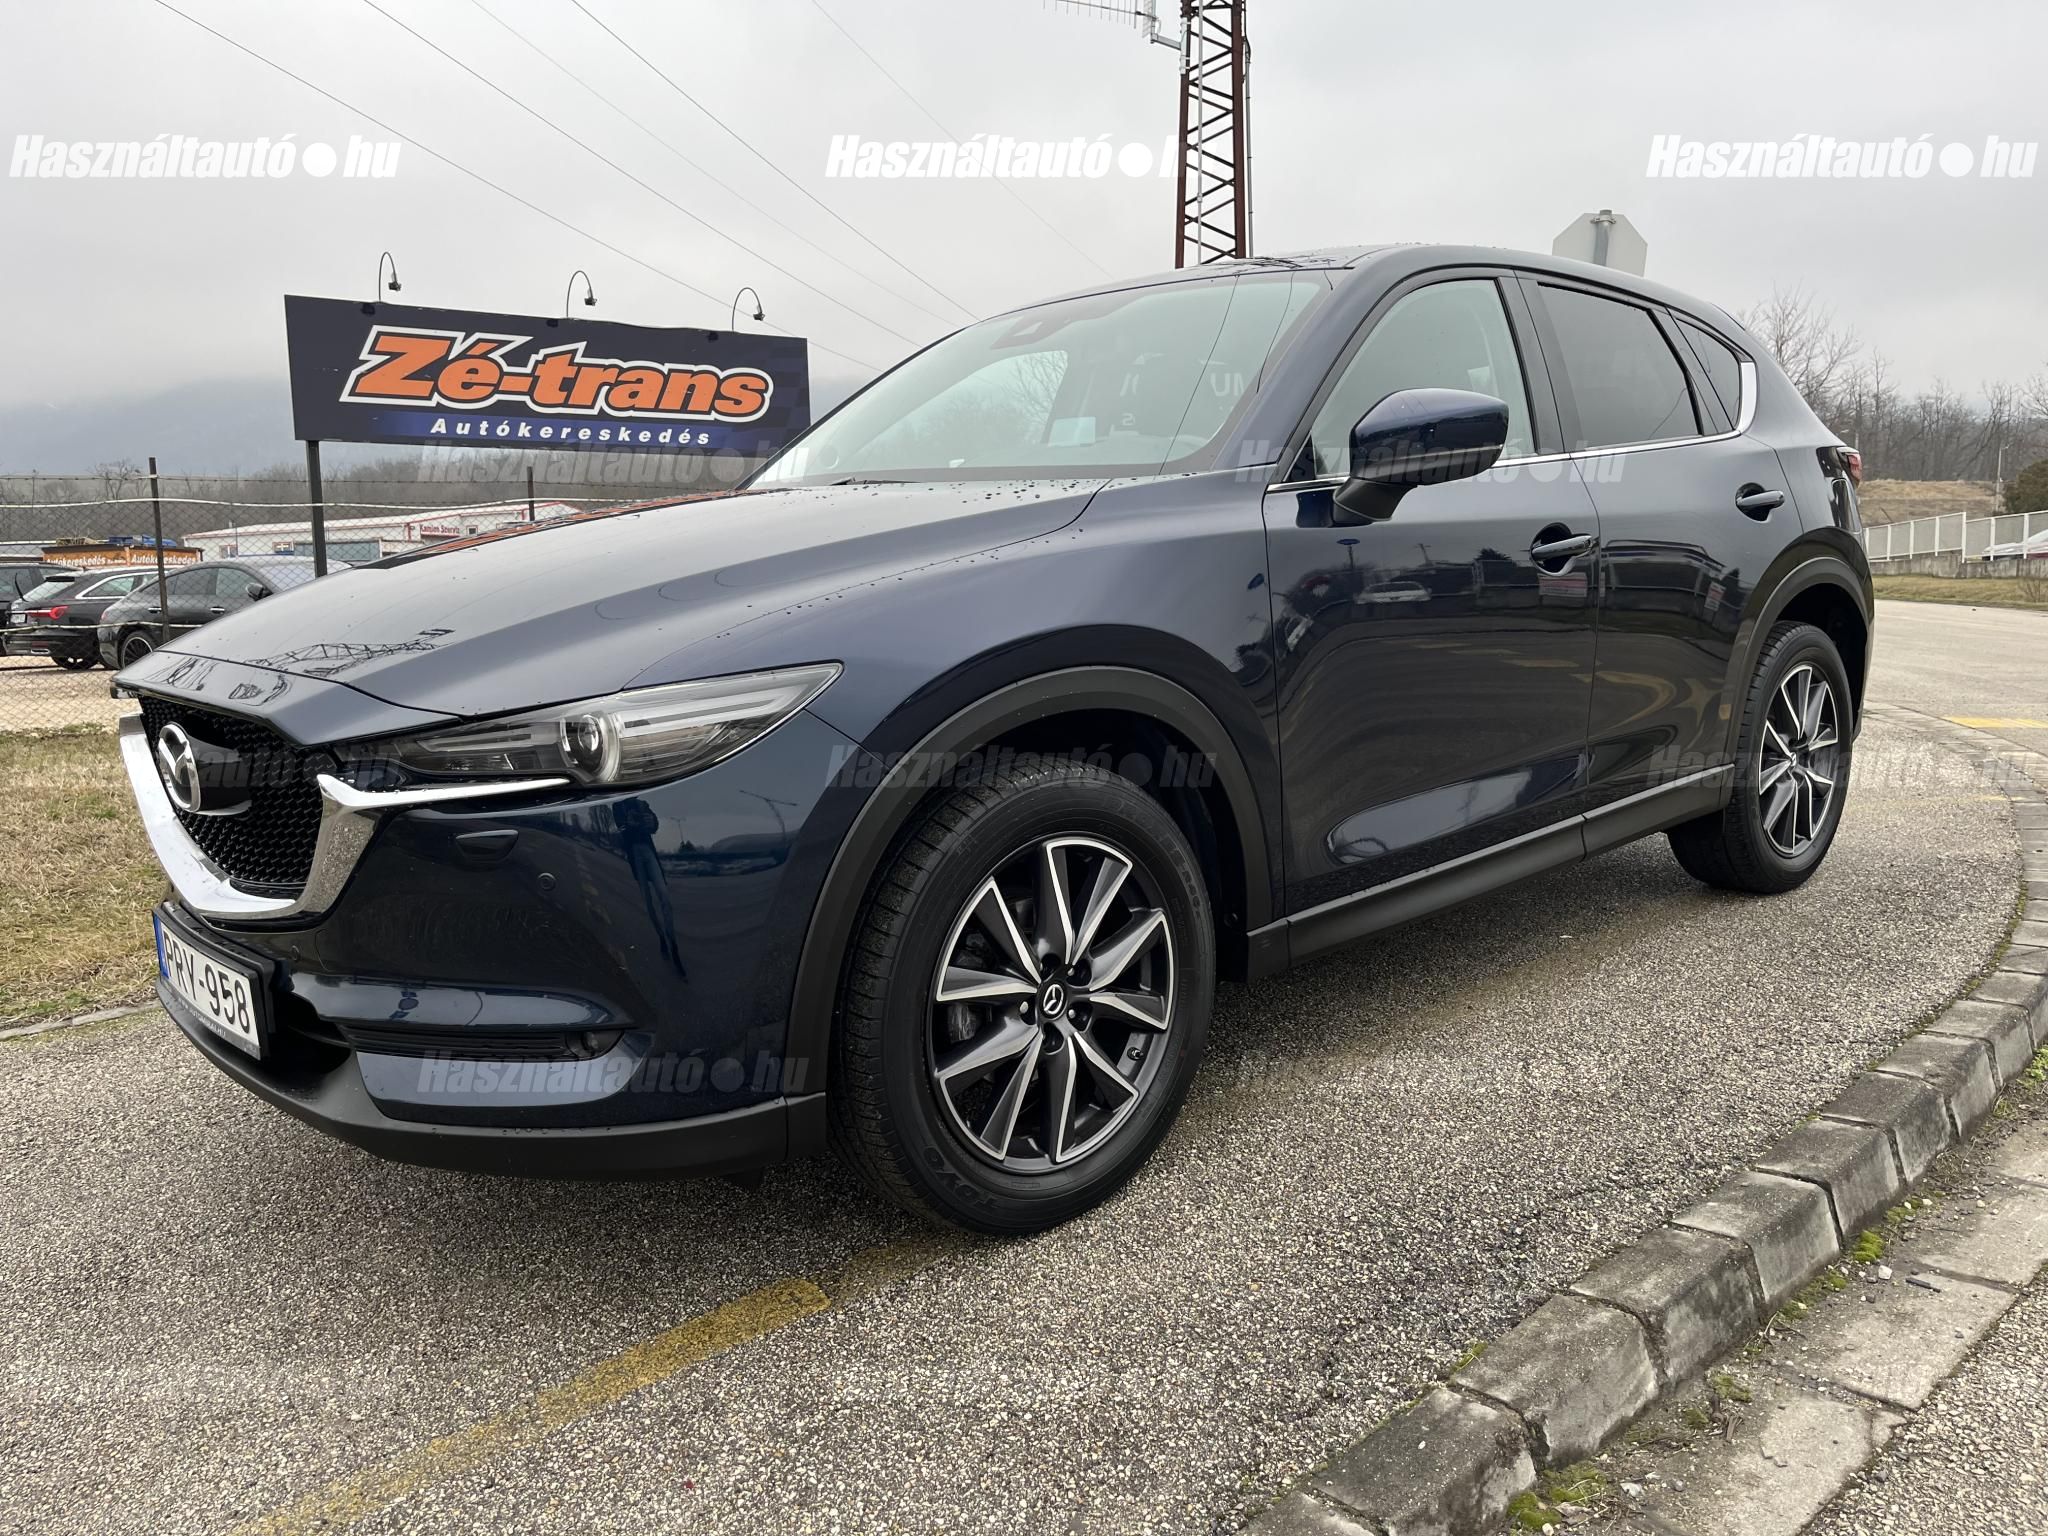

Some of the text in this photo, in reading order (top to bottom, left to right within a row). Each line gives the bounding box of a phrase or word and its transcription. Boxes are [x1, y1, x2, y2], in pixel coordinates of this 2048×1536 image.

[345, 328, 771, 420] Zé-trans
[430, 418, 710, 446] Autókereskedés
[163, 930, 250, 1034] PRY-958
